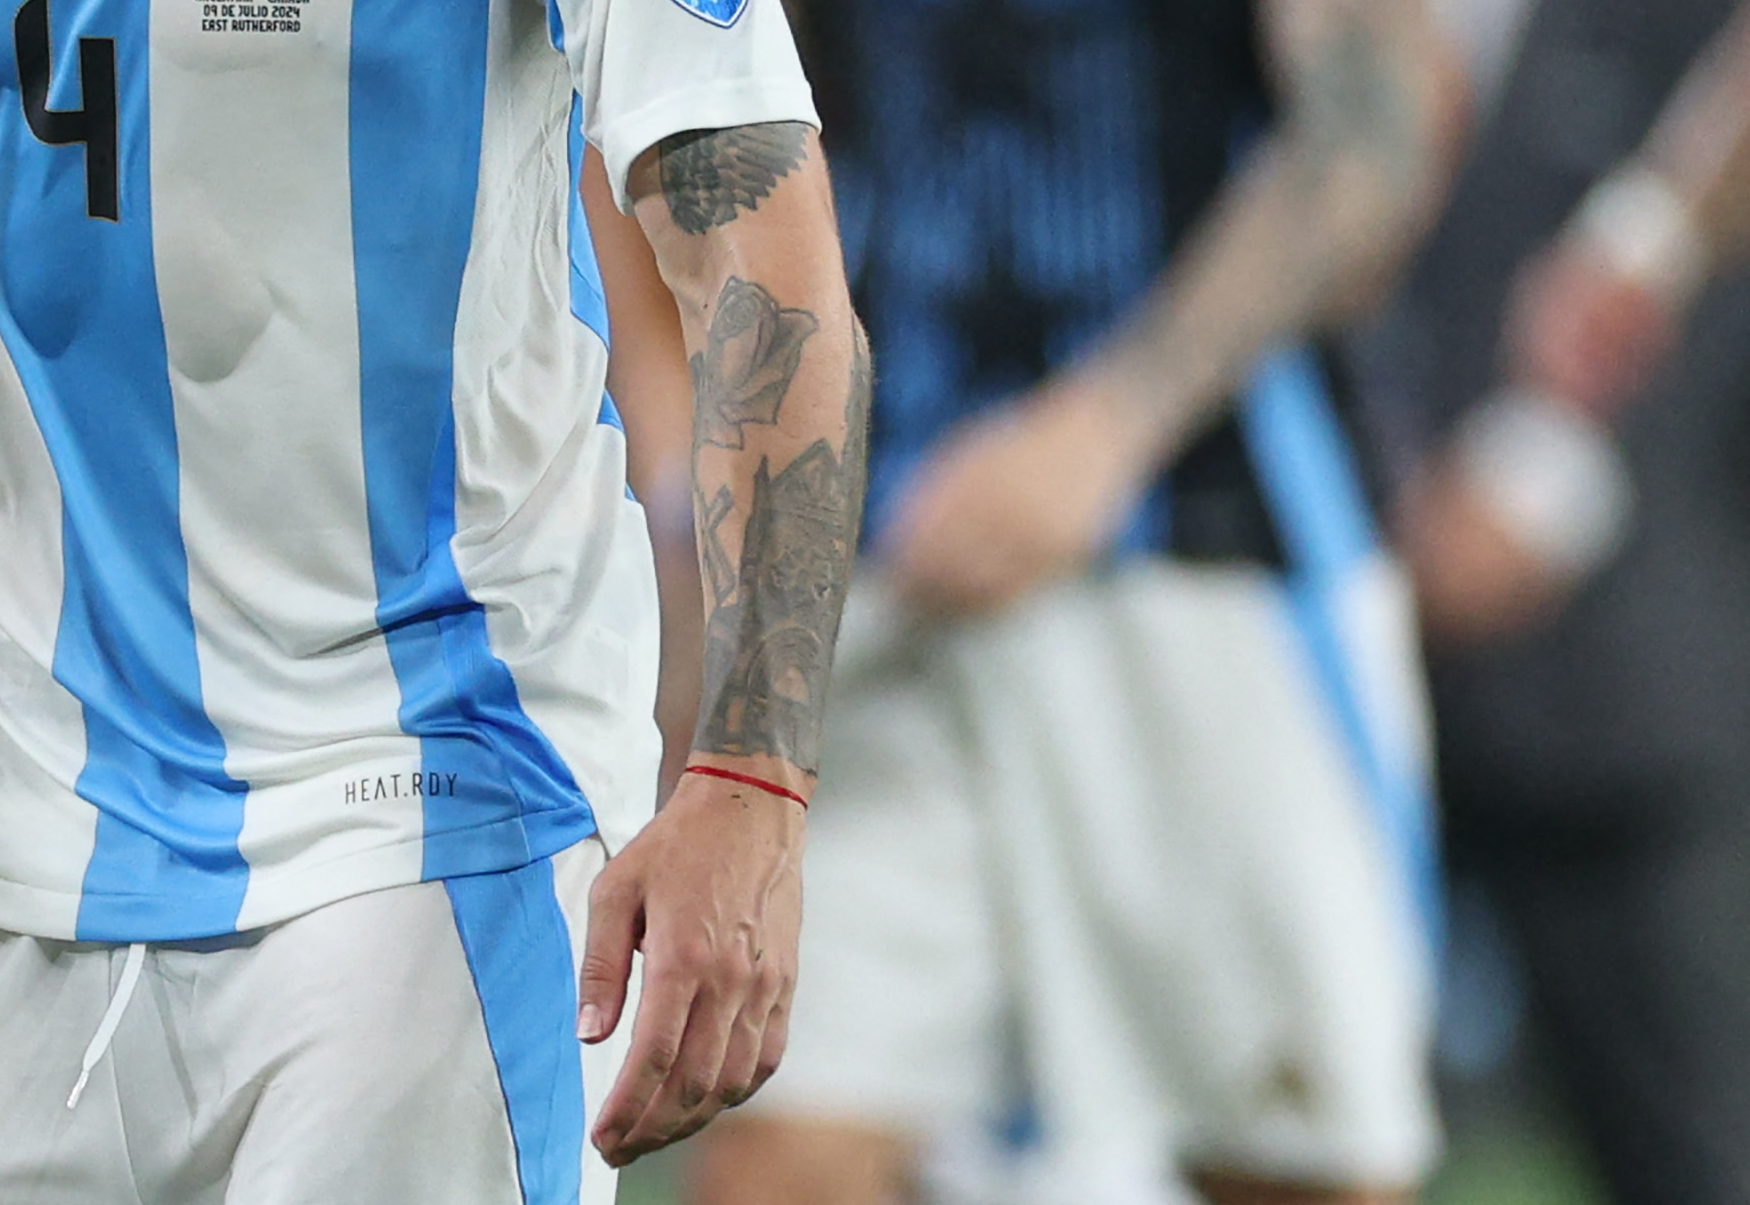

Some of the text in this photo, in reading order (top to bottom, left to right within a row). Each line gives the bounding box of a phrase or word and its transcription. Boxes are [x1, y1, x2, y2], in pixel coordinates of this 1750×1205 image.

[203, 4, 300, 18] 09 DE JULIO 2024
[202, 18, 301, 32] EAST RUTHERFORD
[345, 771, 458, 804] HEAT.RDY
